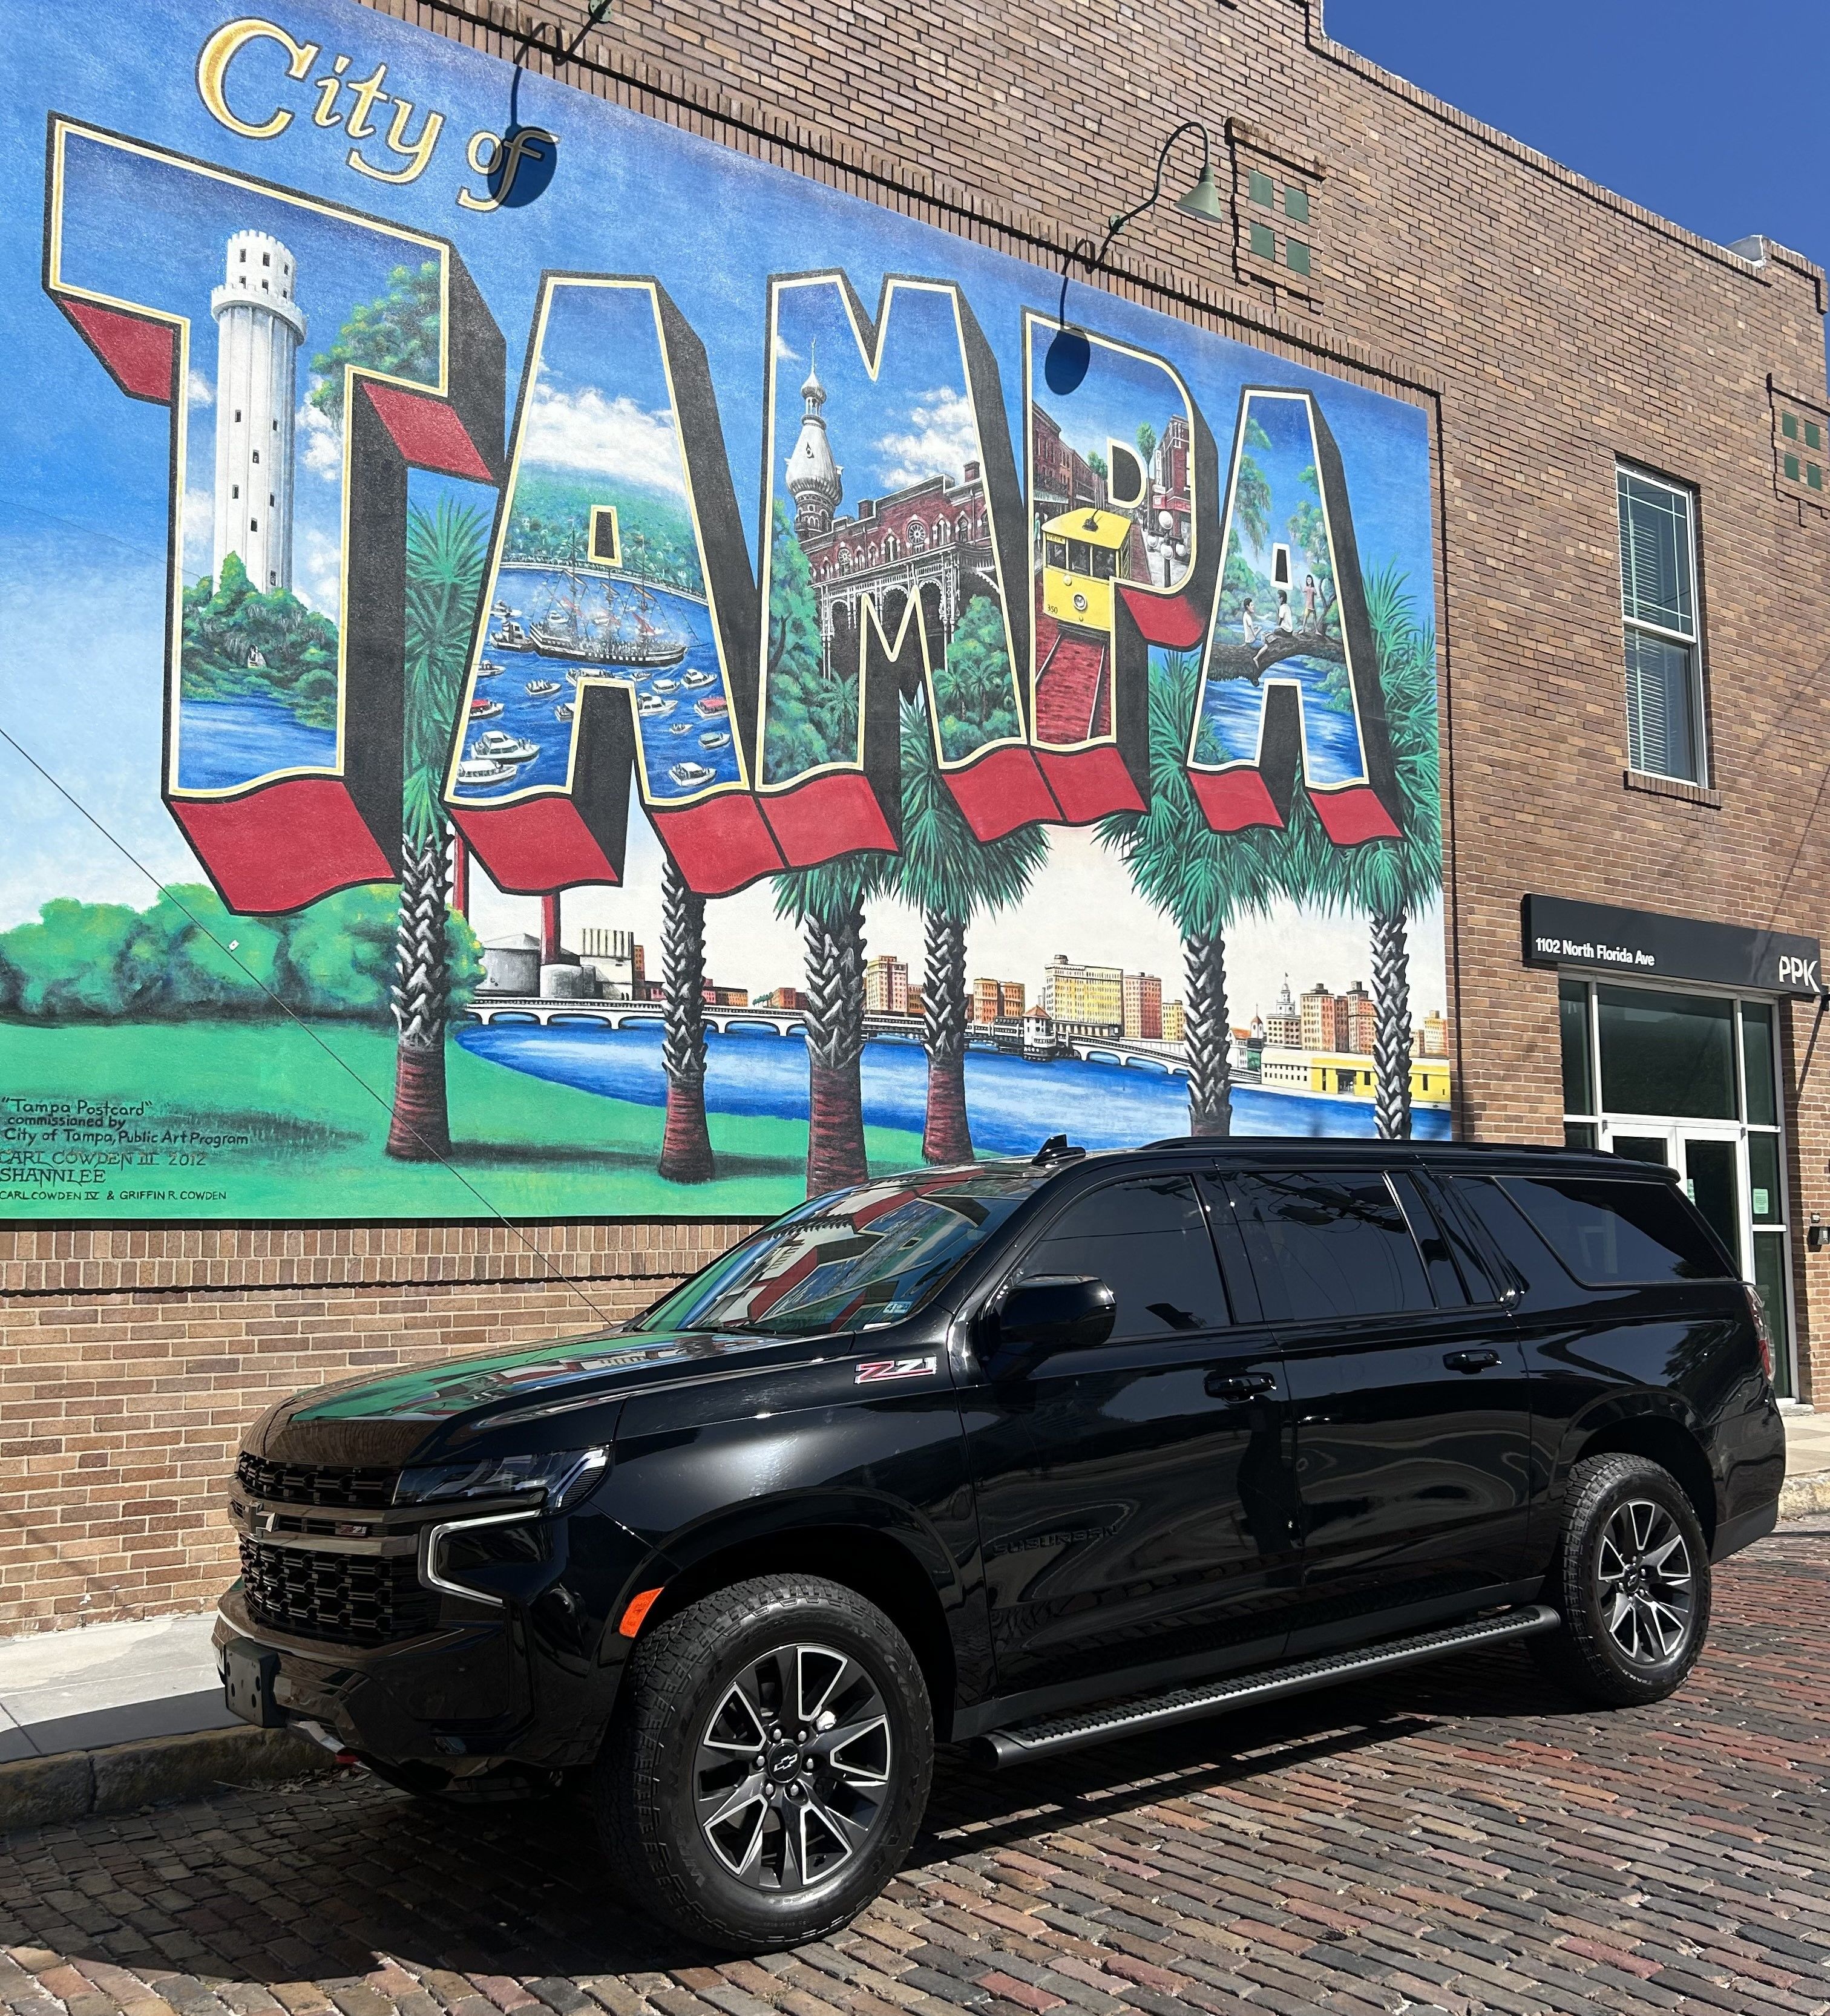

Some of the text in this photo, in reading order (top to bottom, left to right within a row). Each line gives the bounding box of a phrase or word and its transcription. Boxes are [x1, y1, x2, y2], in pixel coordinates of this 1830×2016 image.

[195, 16, 560, 211] City of
[47, 110, 1404, 916] TAMPA
[1048, 604, 1058, 614] 350
[1535, 937, 1655, 966] 1102 North Florida Ave
[1779, 955, 1820, 993] PPK
[108, 1116, 126, 1131] by
[4, 1127, 36, 1146] City
[42, 1128, 58, 1141] of
[118, 1130, 159, 1144] Public
[161, 1130, 188, 1144] Art
[190, 1132, 248, 1148] Program
[0, 1151, 54, 1168] CARL
[52, 1150, 134, 1171] COWDEN
[168, 1152, 207, 1166] 2012
[0, 1191, 29, 1200] CARL
[31, 1191, 82, 1200] COWDEN
[84, 1191, 100, 1200] IV
[107, 1190, 115, 1200] &
[120, 1190, 165, 1200] GRIFFIN
[180, 1191, 226, 1200] COWDEN
